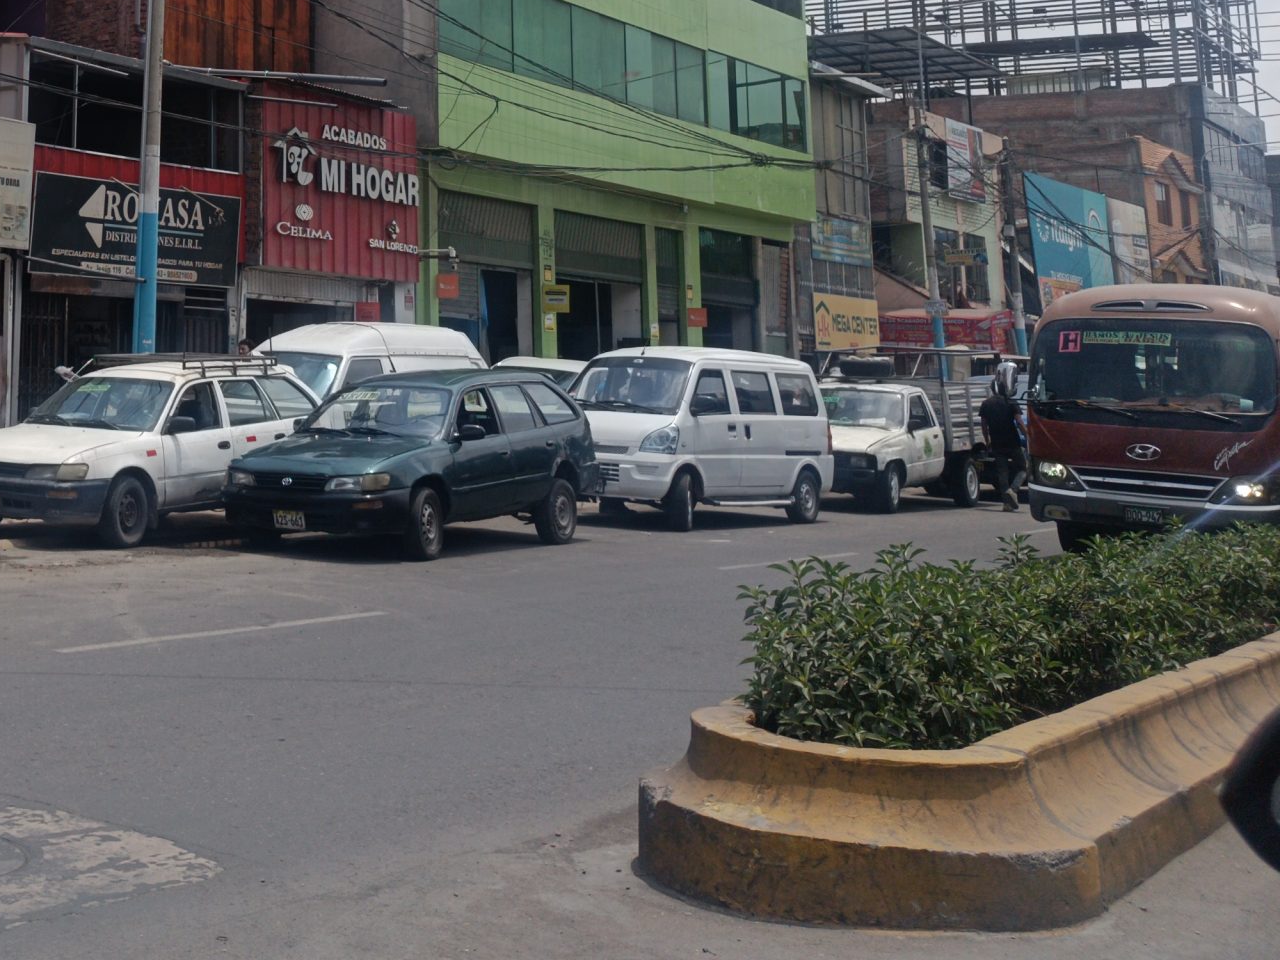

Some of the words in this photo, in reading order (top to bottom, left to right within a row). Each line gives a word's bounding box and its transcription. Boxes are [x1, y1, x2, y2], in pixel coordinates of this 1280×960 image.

[322, 124, 387, 151] ACABADOS
[5, 177, 20, 187] OBRA
[321, 157, 346, 194] MI
[352, 162, 420, 207] HOGAR
[106, 190, 205, 230] ROASA
[51, 248, 100, 259] ESPECIALISTAS
[369, 238, 385, 249] SAN
[386, 240, 418, 255] LORENZO
[832, 314, 851, 334] MEGA
[852, 316, 878, 336] CENTER
